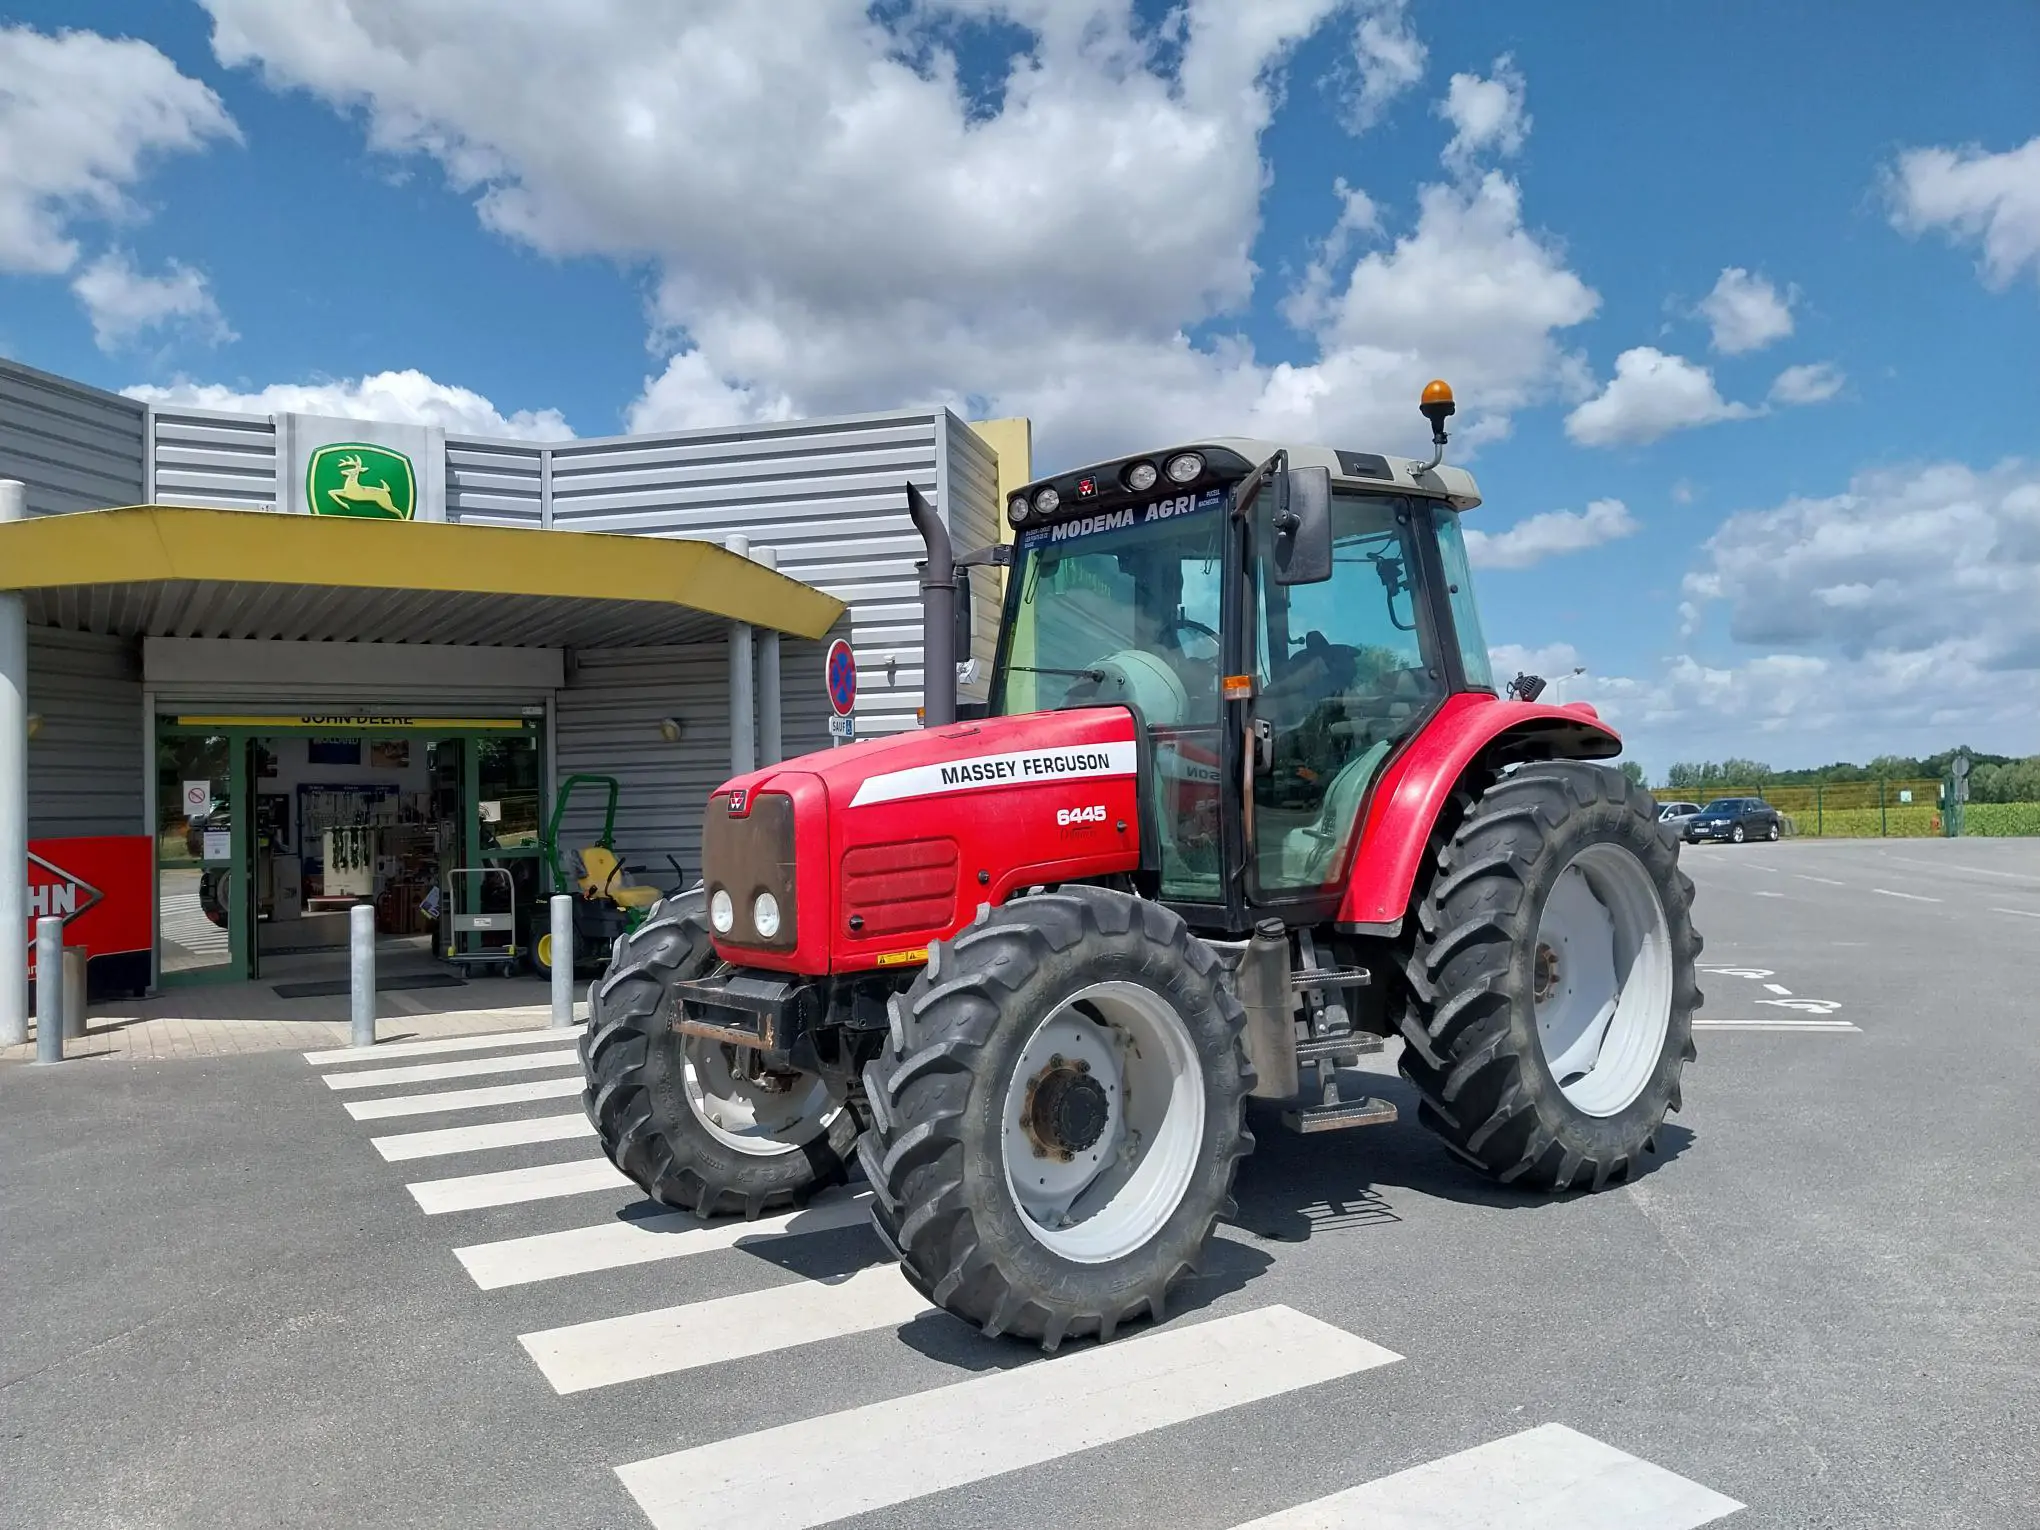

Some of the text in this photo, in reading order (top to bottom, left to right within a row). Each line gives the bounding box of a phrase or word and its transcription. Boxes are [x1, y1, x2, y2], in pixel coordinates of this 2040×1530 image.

[1051, 494, 1196, 542] MODEMA AGRI
[832, 721, 846, 732] SAUF
[940, 753, 1111, 785] MASSEY FERGUSON
[1056, 805, 1107, 826] 6445
[28, 882, 76, 917] HN
